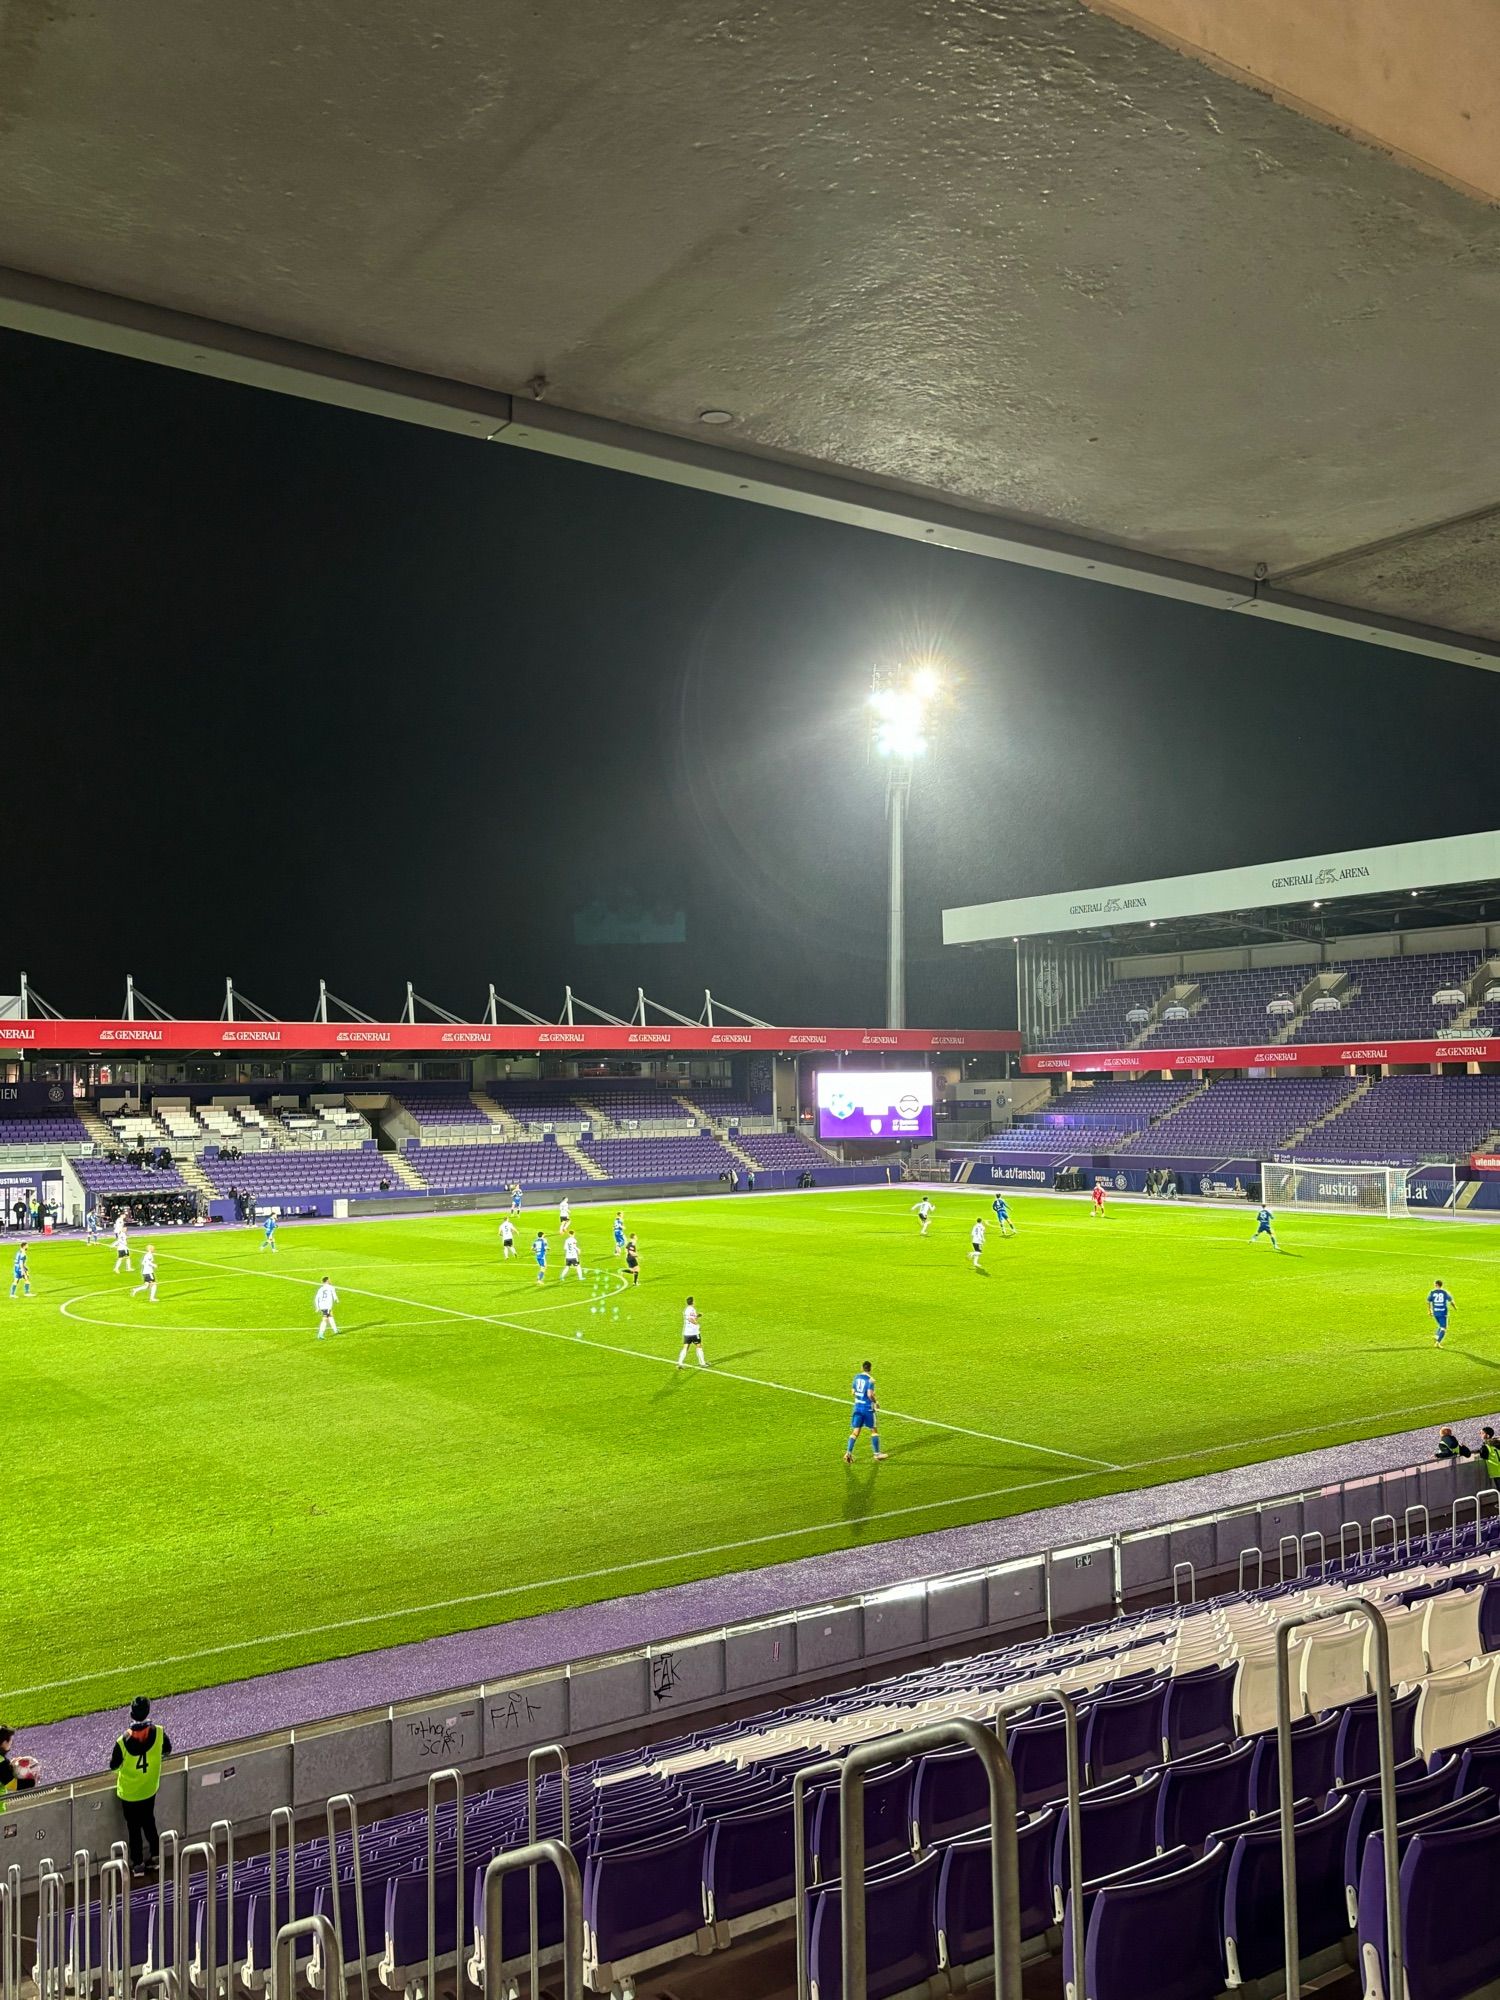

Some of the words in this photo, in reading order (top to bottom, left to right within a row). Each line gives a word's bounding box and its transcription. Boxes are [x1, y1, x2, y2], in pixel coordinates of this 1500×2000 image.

[1271, 874, 1313, 888] GENERALI
[1339, 866, 1370, 879] ARENA
[1069, 903, 1102, 915] GENERALI
[1122, 897, 1147, 910] ARENA
[115, 1030, 162, 1040] GENERALI
[236, 1031, 281, 1041] GENERALI
[350, 1032, 390, 1041] GENERALI
[454, 1033, 491, 1042] GENERALI
[550, 1033, 585, 1042] GENERALI
[638, 1034, 671, 1042] GENERALI
[721, 1034, 752, 1043] GENERALI
[798, 1035, 827, 1043] GENERALI
[870, 1036, 898, 1044] GENERALI
[1351, 1049, 1388, 1059] GENERALI
[1447, 1046, 1487, 1056] GENERALI
[1111, 1057, 1140, 1066] GENERALI
[1184, 1055, 1215, 1064] GENERALI
[1264, 1052, 1297, 1062] GENERALI
[991, 1166, 1046, 1183] fak.at/fanshop
[19, 1176, 33, 1184] WIEN
[1433, 1292, 1445, 1303] 28
[135, 1750, 149, 1774] 4
